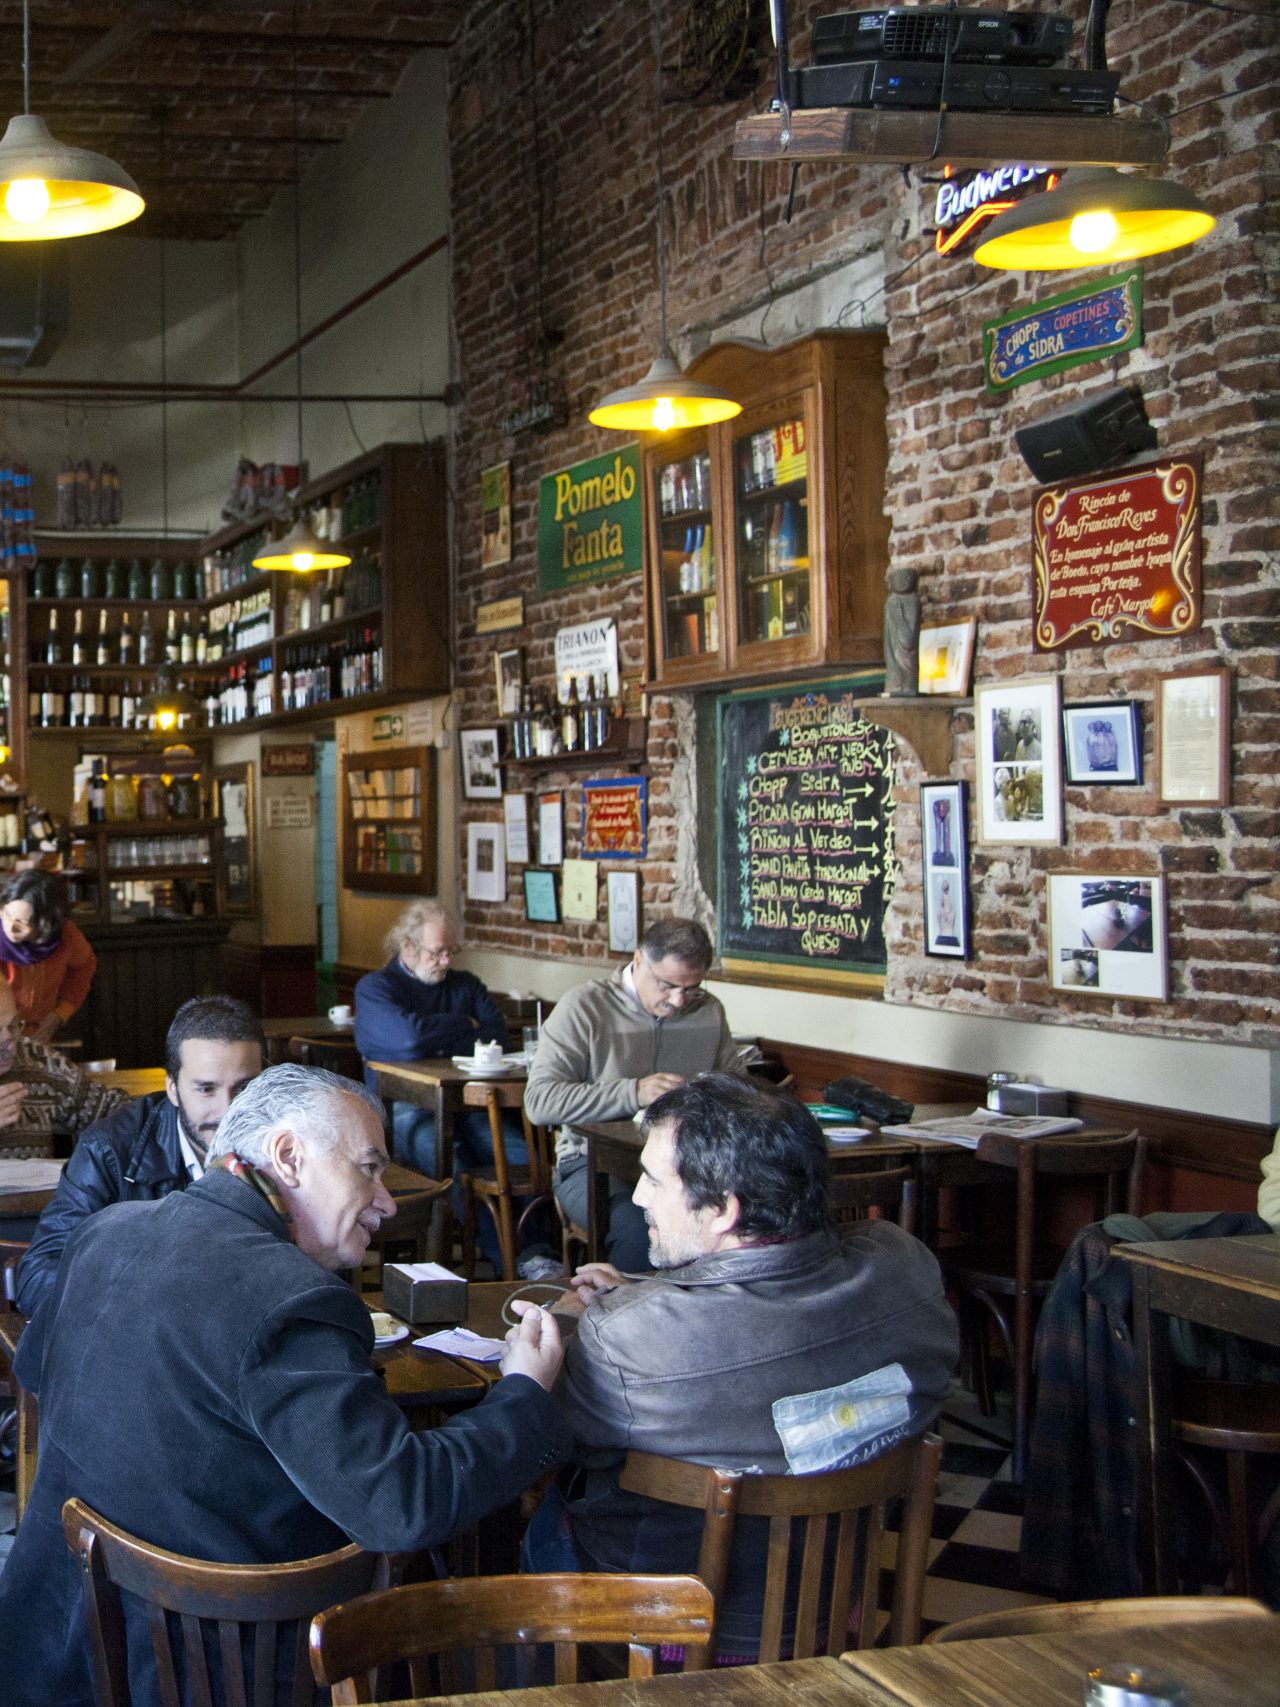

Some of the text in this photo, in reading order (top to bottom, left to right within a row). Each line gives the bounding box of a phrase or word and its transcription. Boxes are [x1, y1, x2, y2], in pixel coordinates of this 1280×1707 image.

[978, 20, 999, 28] EPSON
[1005, 300, 1110, 358] CHOPP COPETINES
[1028, 333, 1065, 360] SIDRA
[554, 455, 635, 522] Pomelo
[1079, 490, 1131, 515] Rincón de
[1055, 507, 1158, 542] Don Francisco Reyes
[562, 519, 624, 570] Fanta
[1050, 549, 1063, 563] En
[1064, 542, 1102, 562] homenaje
[1103, 540, 1114, 555] al
[1135, 533, 1169, 548] artista
[1050, 569, 1061, 581] de
[1090, 562, 1110, 577] cuyo
[1146, 551, 1171, 570] honra
[1050, 588, 1067, 599] esta
[1069, 580, 1100, 599] esquina
[1091, 595, 1115, 621] Café
[558, 627, 607, 651] TRIANON
